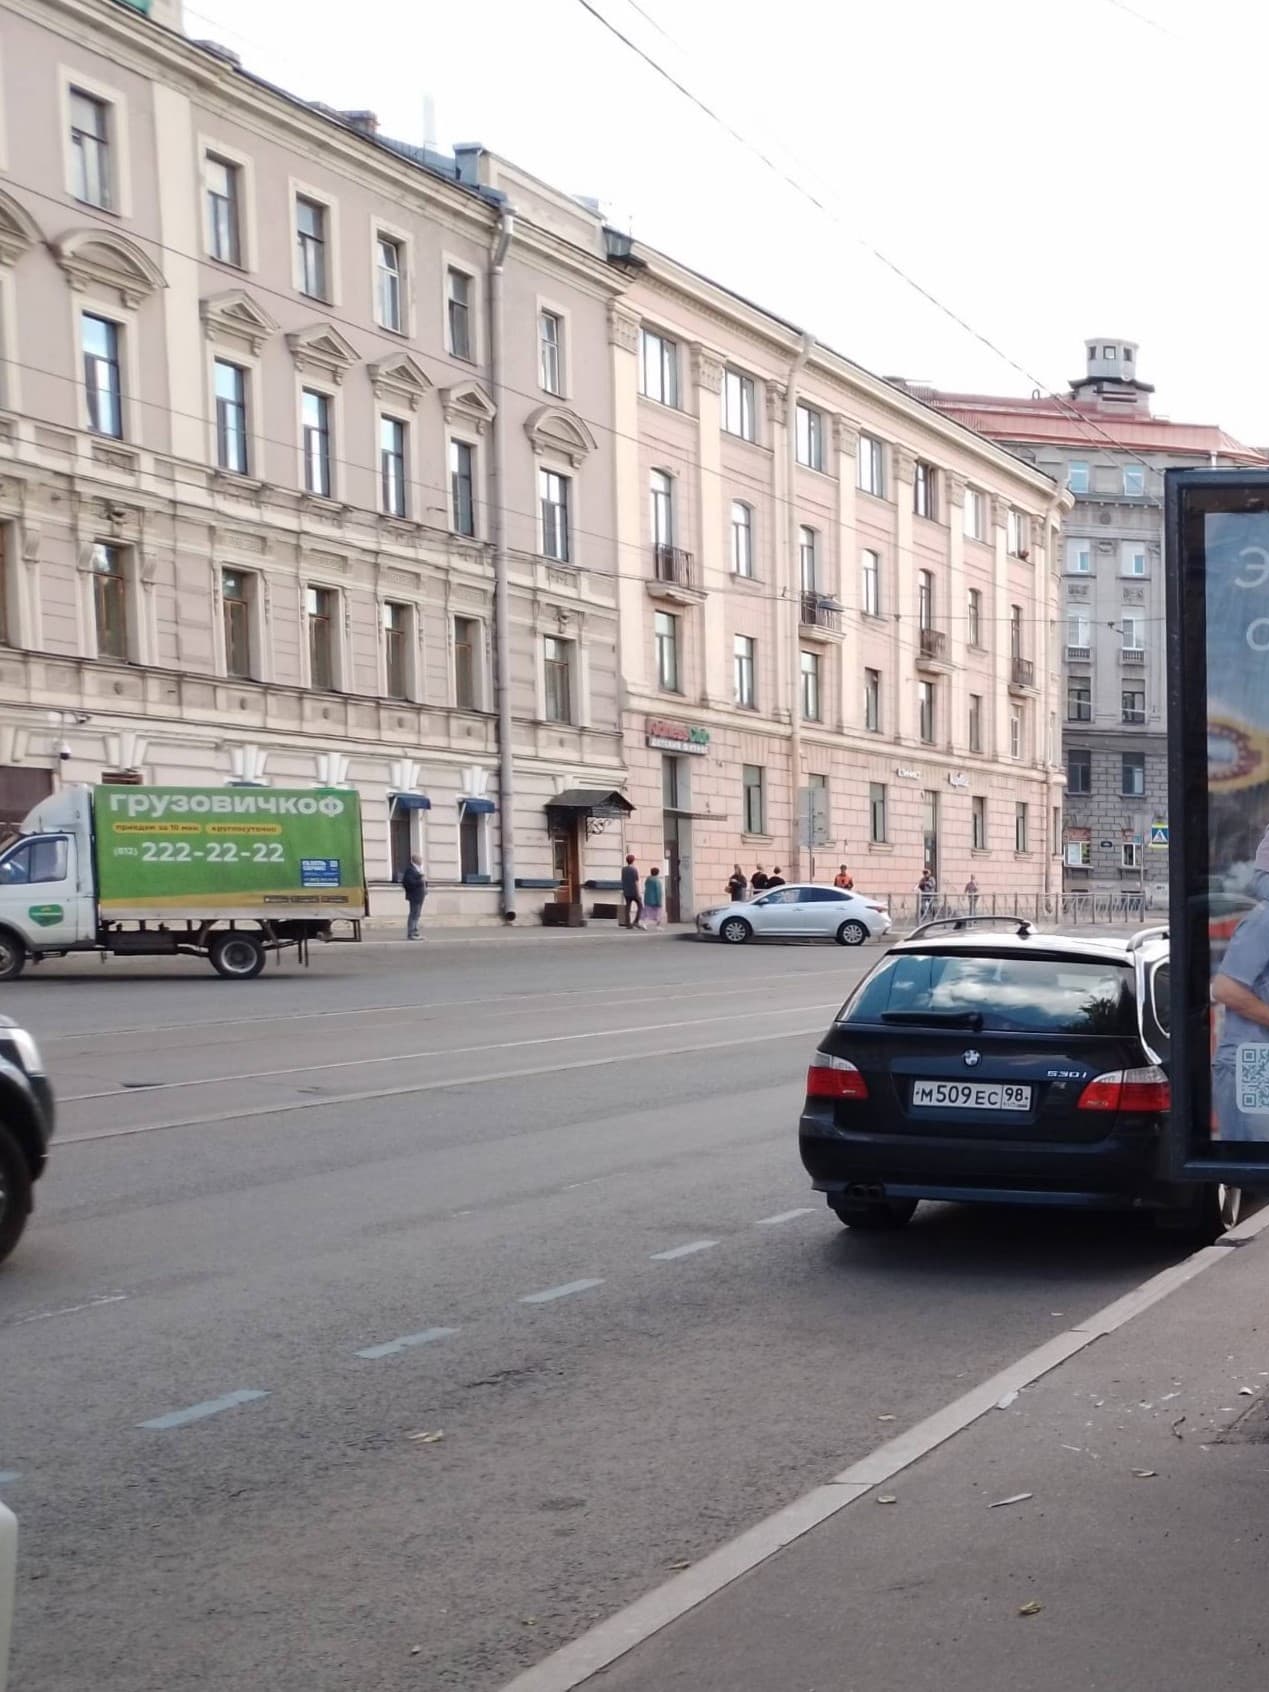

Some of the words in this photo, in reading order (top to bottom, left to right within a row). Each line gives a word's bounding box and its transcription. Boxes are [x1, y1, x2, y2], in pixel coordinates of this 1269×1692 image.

[109, 793, 344, 818] грузовичкоф
[142, 842, 285, 862] 222-22-22
[1004, 1088, 1024, 1102] 98
